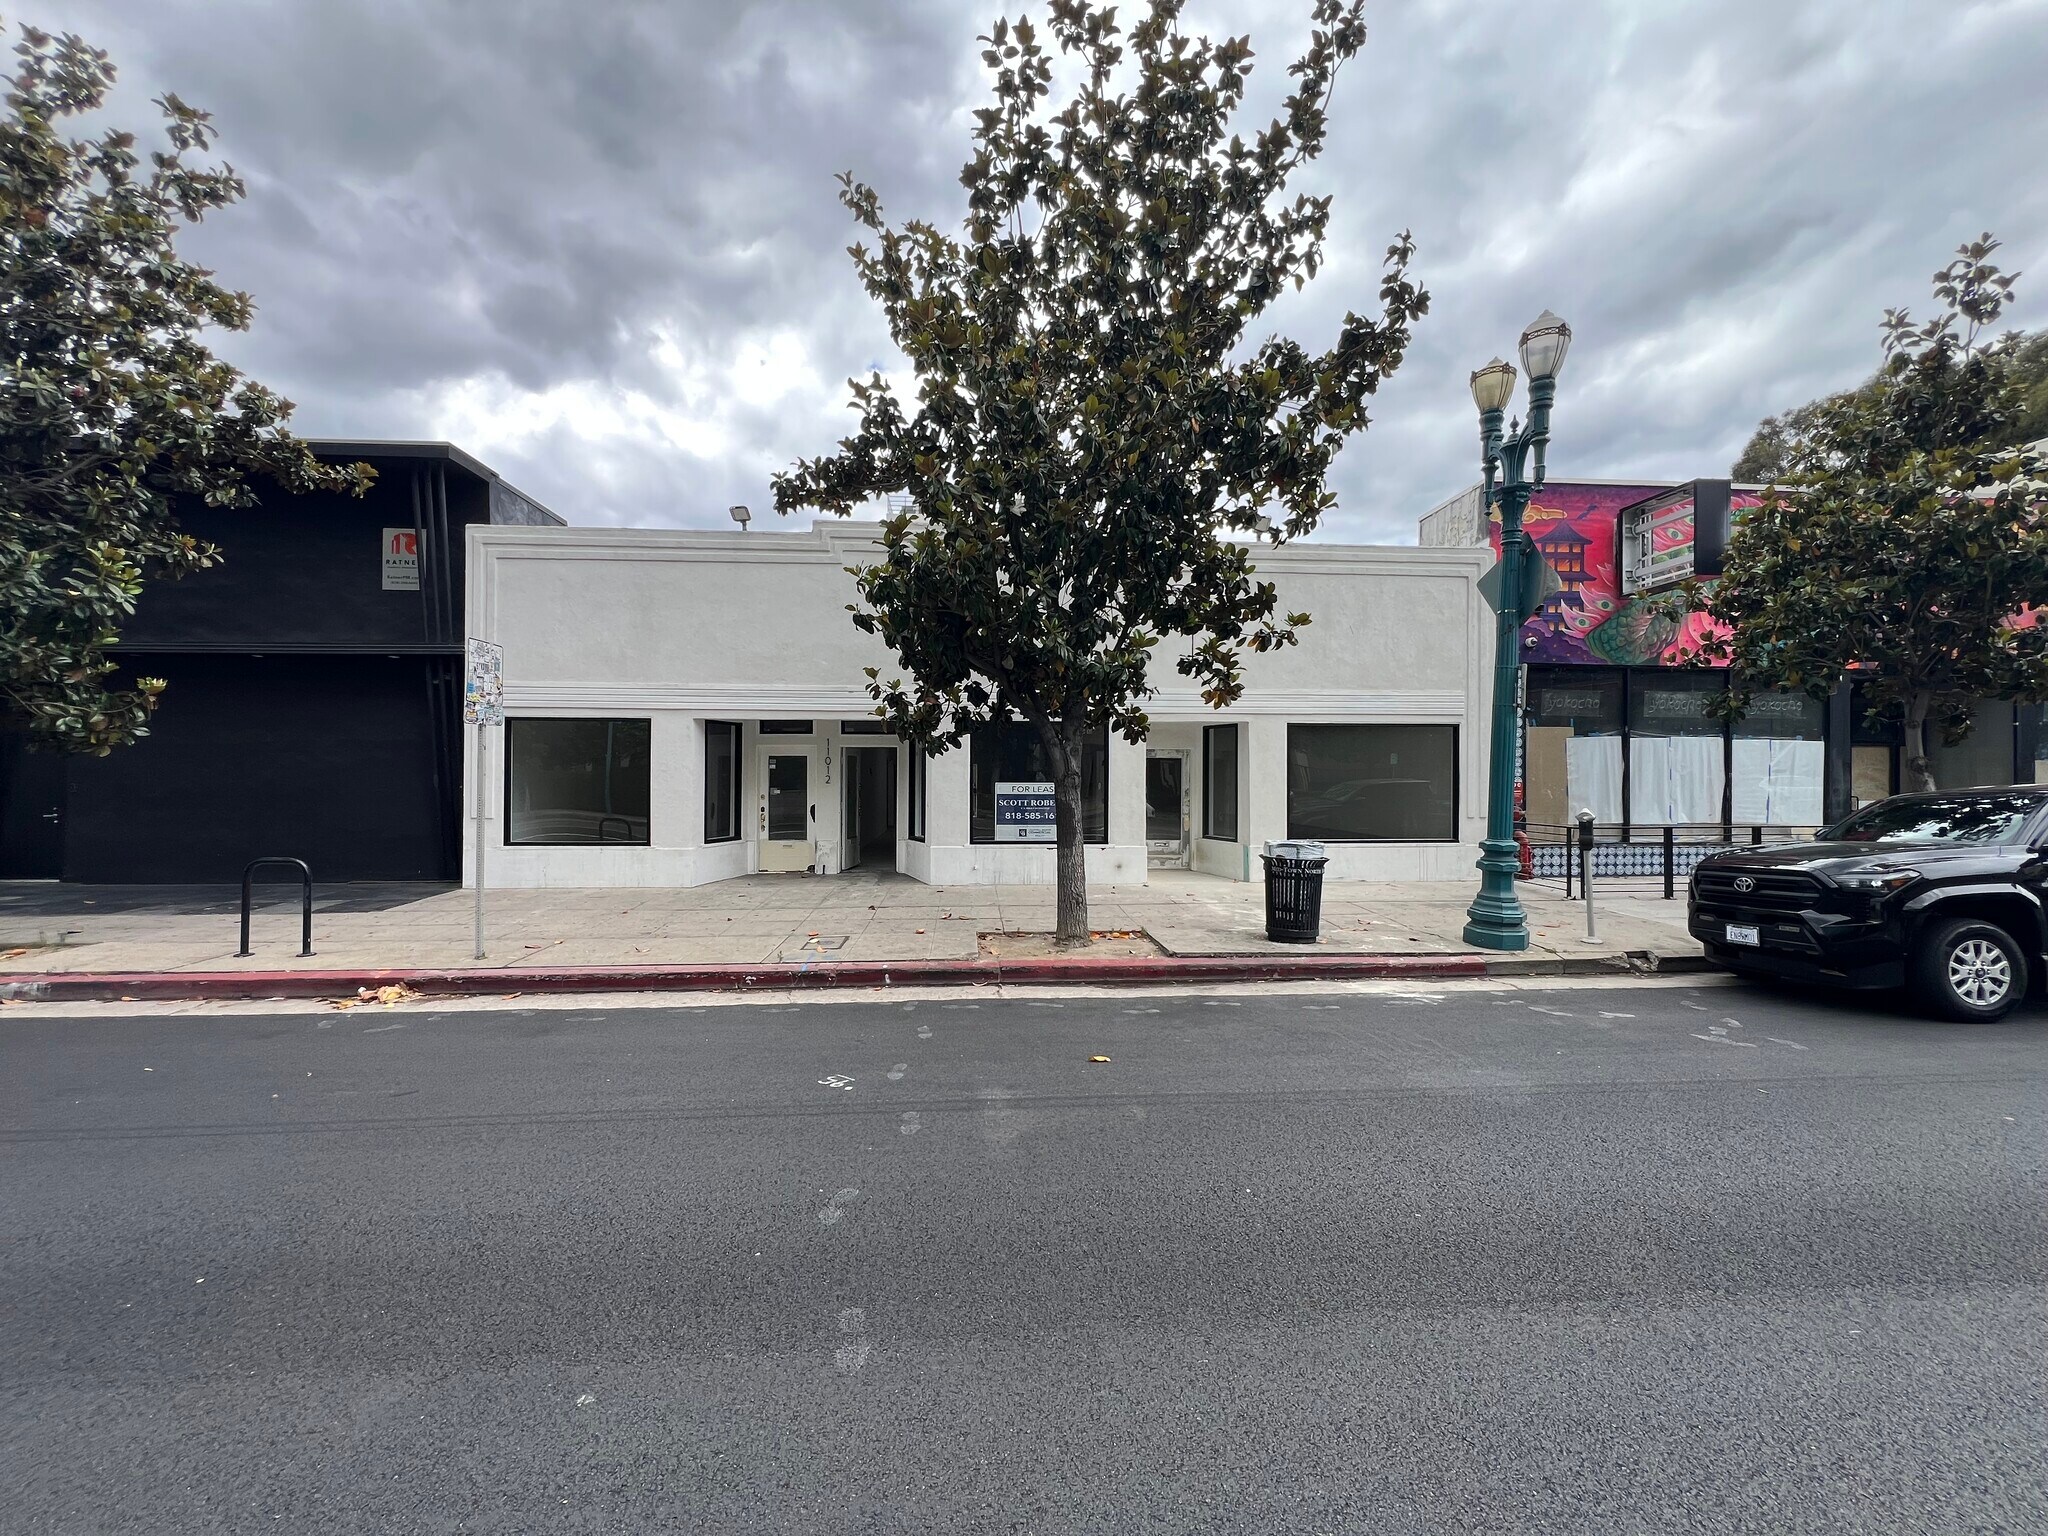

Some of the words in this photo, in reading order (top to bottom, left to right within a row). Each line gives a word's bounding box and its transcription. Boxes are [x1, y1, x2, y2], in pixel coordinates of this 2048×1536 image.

[1012, 785, 1030, 793] FOR
[1033, 785, 1054, 793] LEAS
[999, 799, 1028, 807] SCOTT
[1031, 799, 1056, 807] ROBE
[1005, 812, 1056, 820] 818-585-16
